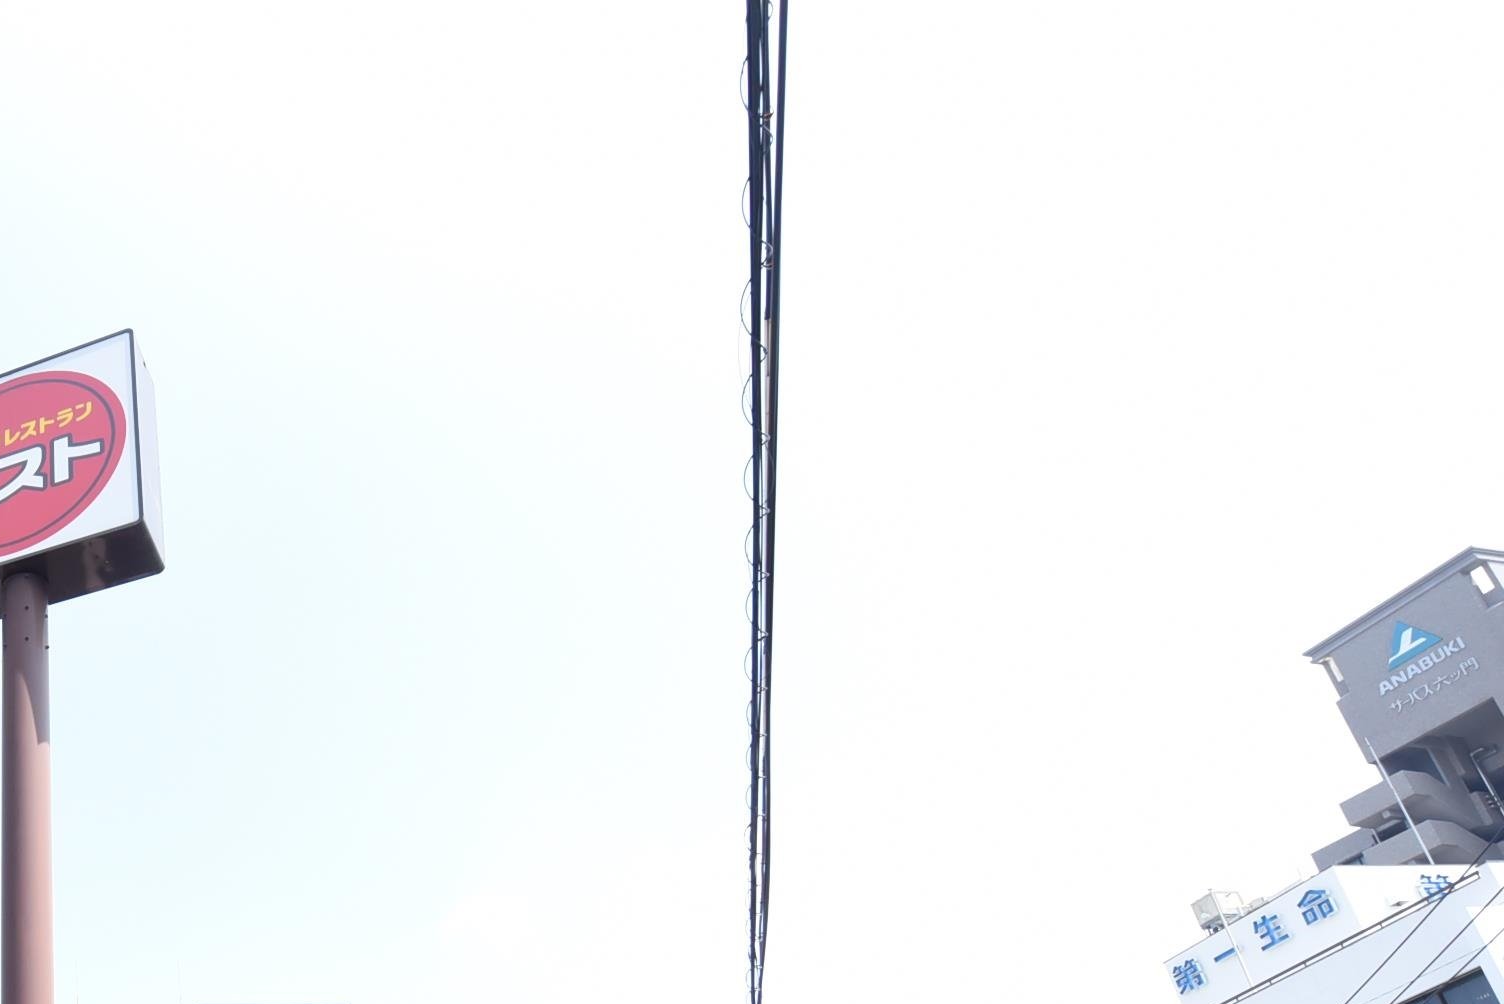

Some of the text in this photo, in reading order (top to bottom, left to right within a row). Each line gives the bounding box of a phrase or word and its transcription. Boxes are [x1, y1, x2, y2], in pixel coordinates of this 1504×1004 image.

[1378, 636, 1466, 696] ANABUKI
[1172, 888, 1340, 996] 第一生命
